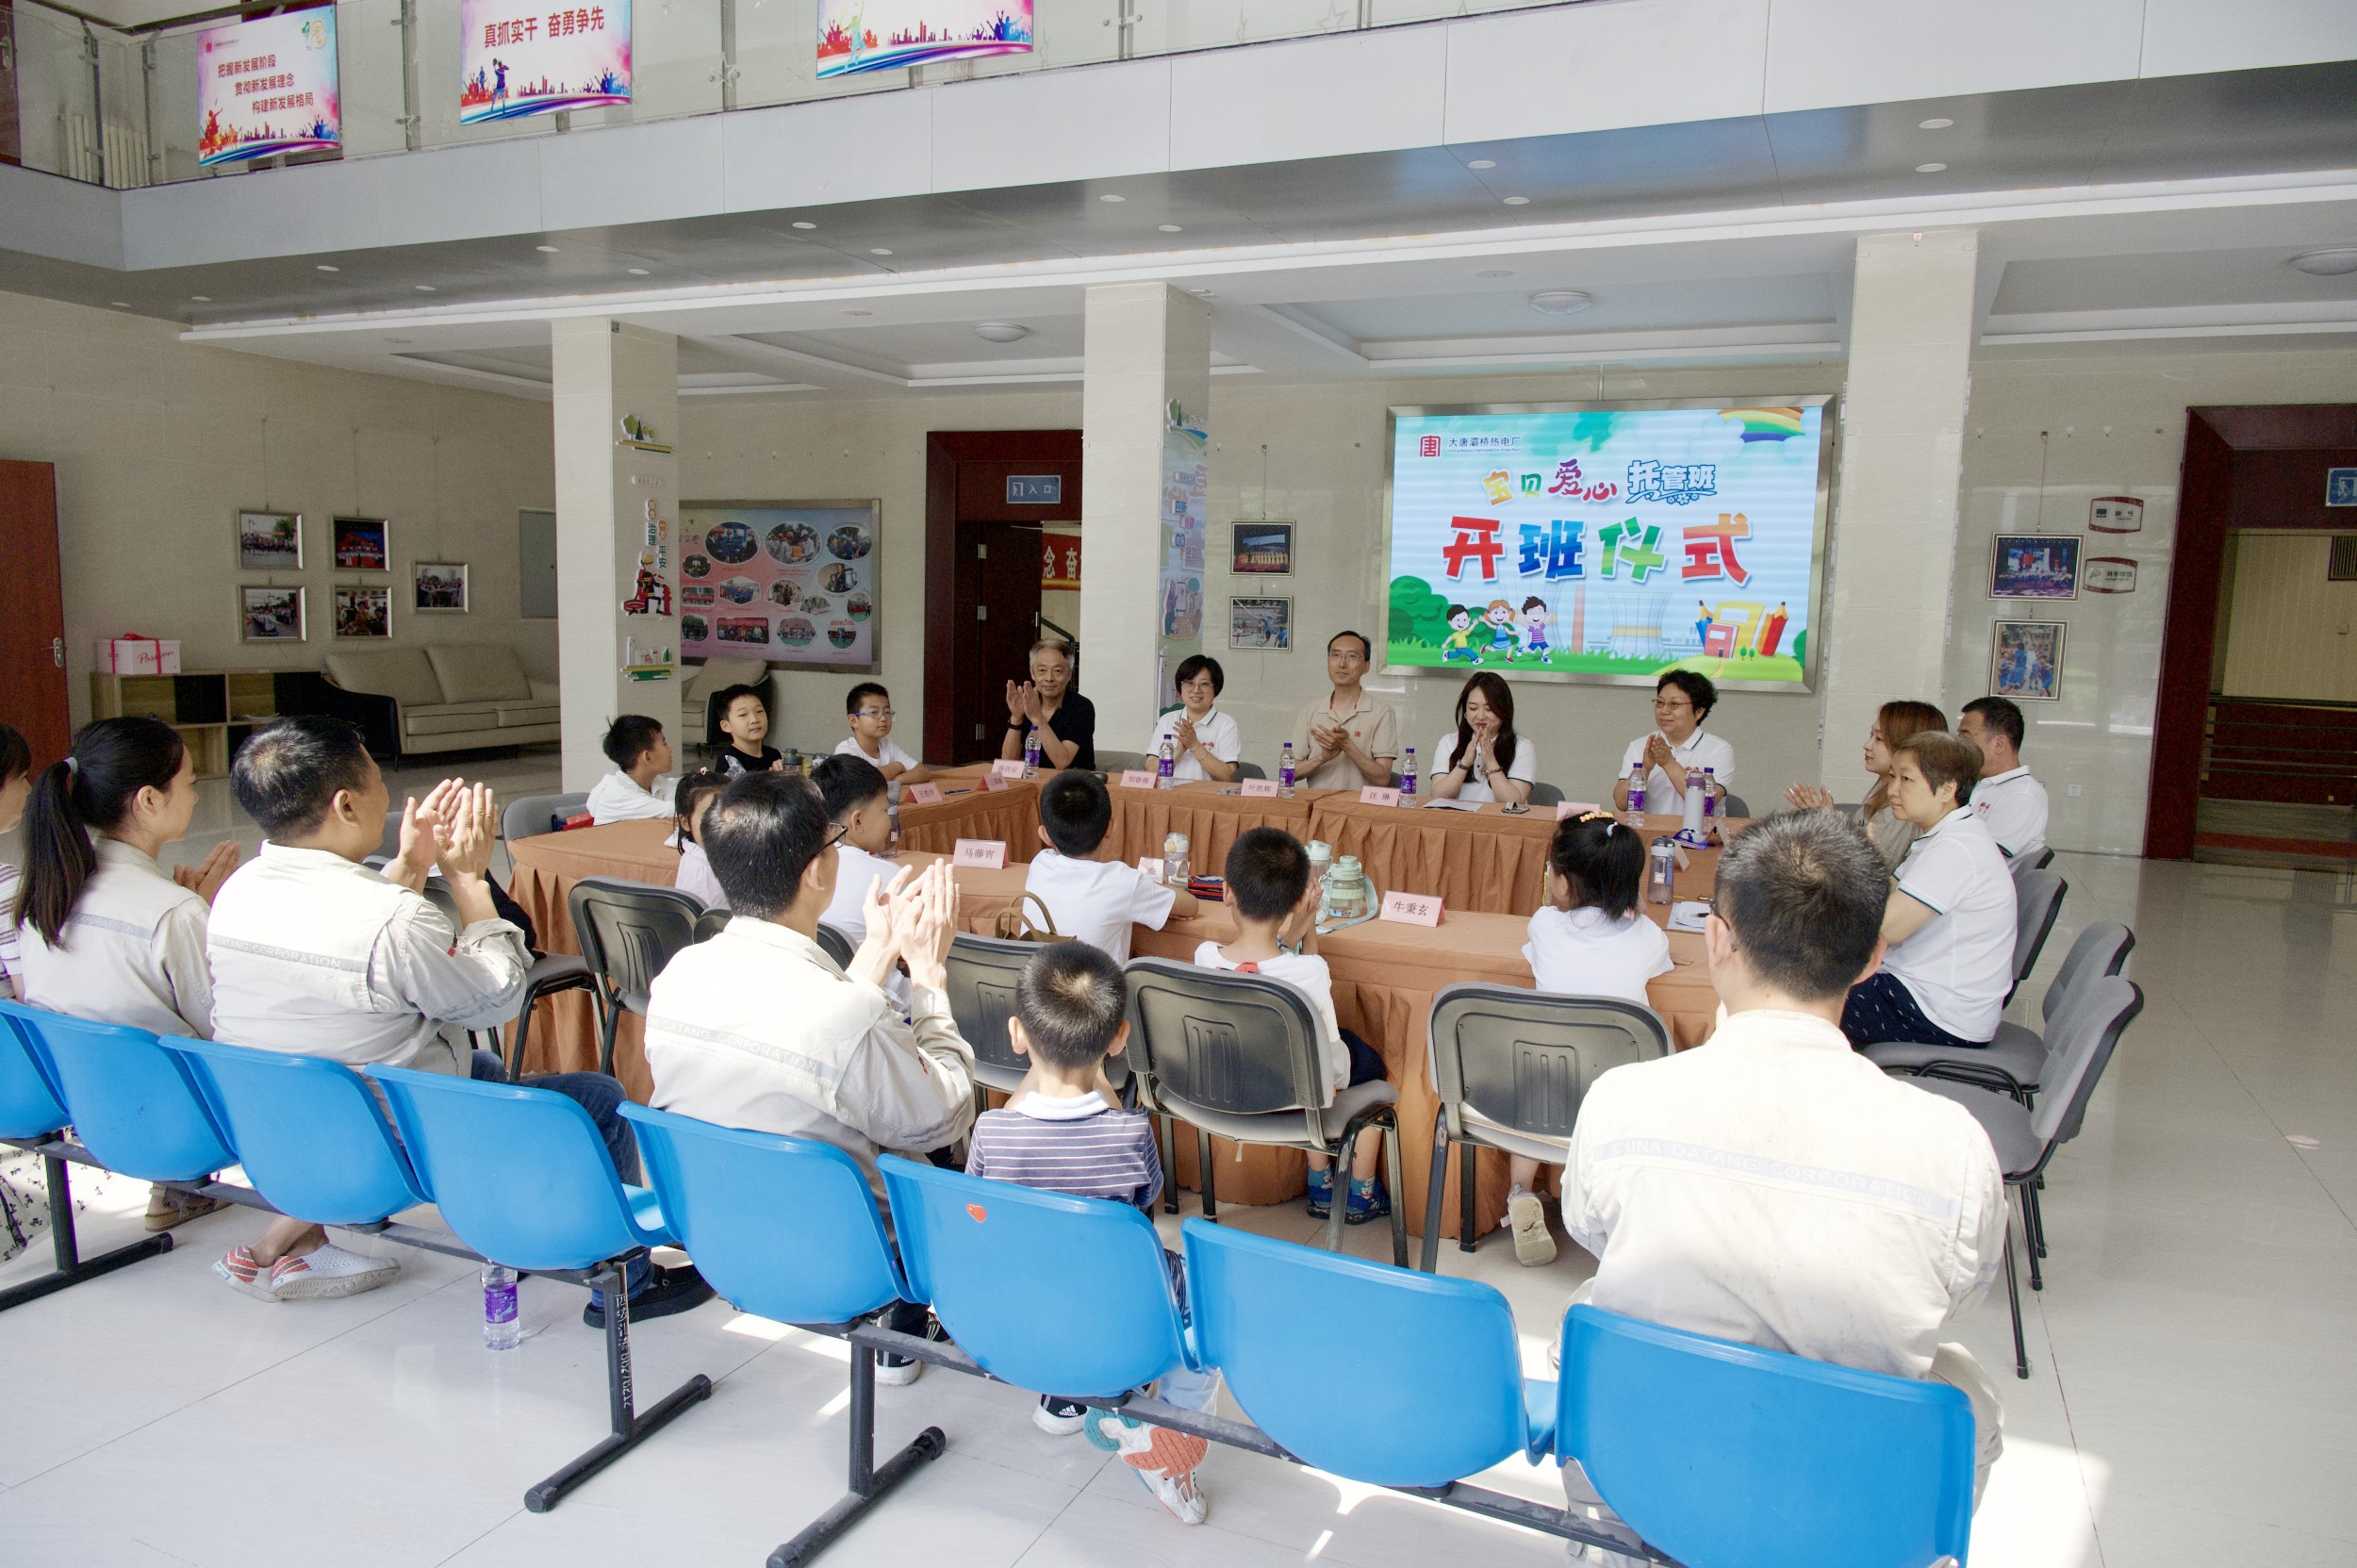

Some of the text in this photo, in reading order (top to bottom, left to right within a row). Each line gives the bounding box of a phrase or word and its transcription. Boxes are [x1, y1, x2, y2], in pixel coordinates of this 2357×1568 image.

[484, 6, 604, 48] 真抓实干 奋勇争先
[218, 54, 276, 78] 把握新发展阶段
[235, 73, 295, 96] 贯彻新发展理念
[252, 92, 314, 114] 构建新发展格局
[1448, 437, 1522, 447] 大唐灞桥热电厂
[1442, 512, 1752, 586] 开班仪式
[216, 936, 249, 951] DATANG
[253, 944, 340, 968] CORPORATION
[663, 1019, 818, 1072] DATANG CORPORATION
[1672, 1143, 1757, 1171] DATANG
[1769, 1161, 1932, 1207] CORPORATION
